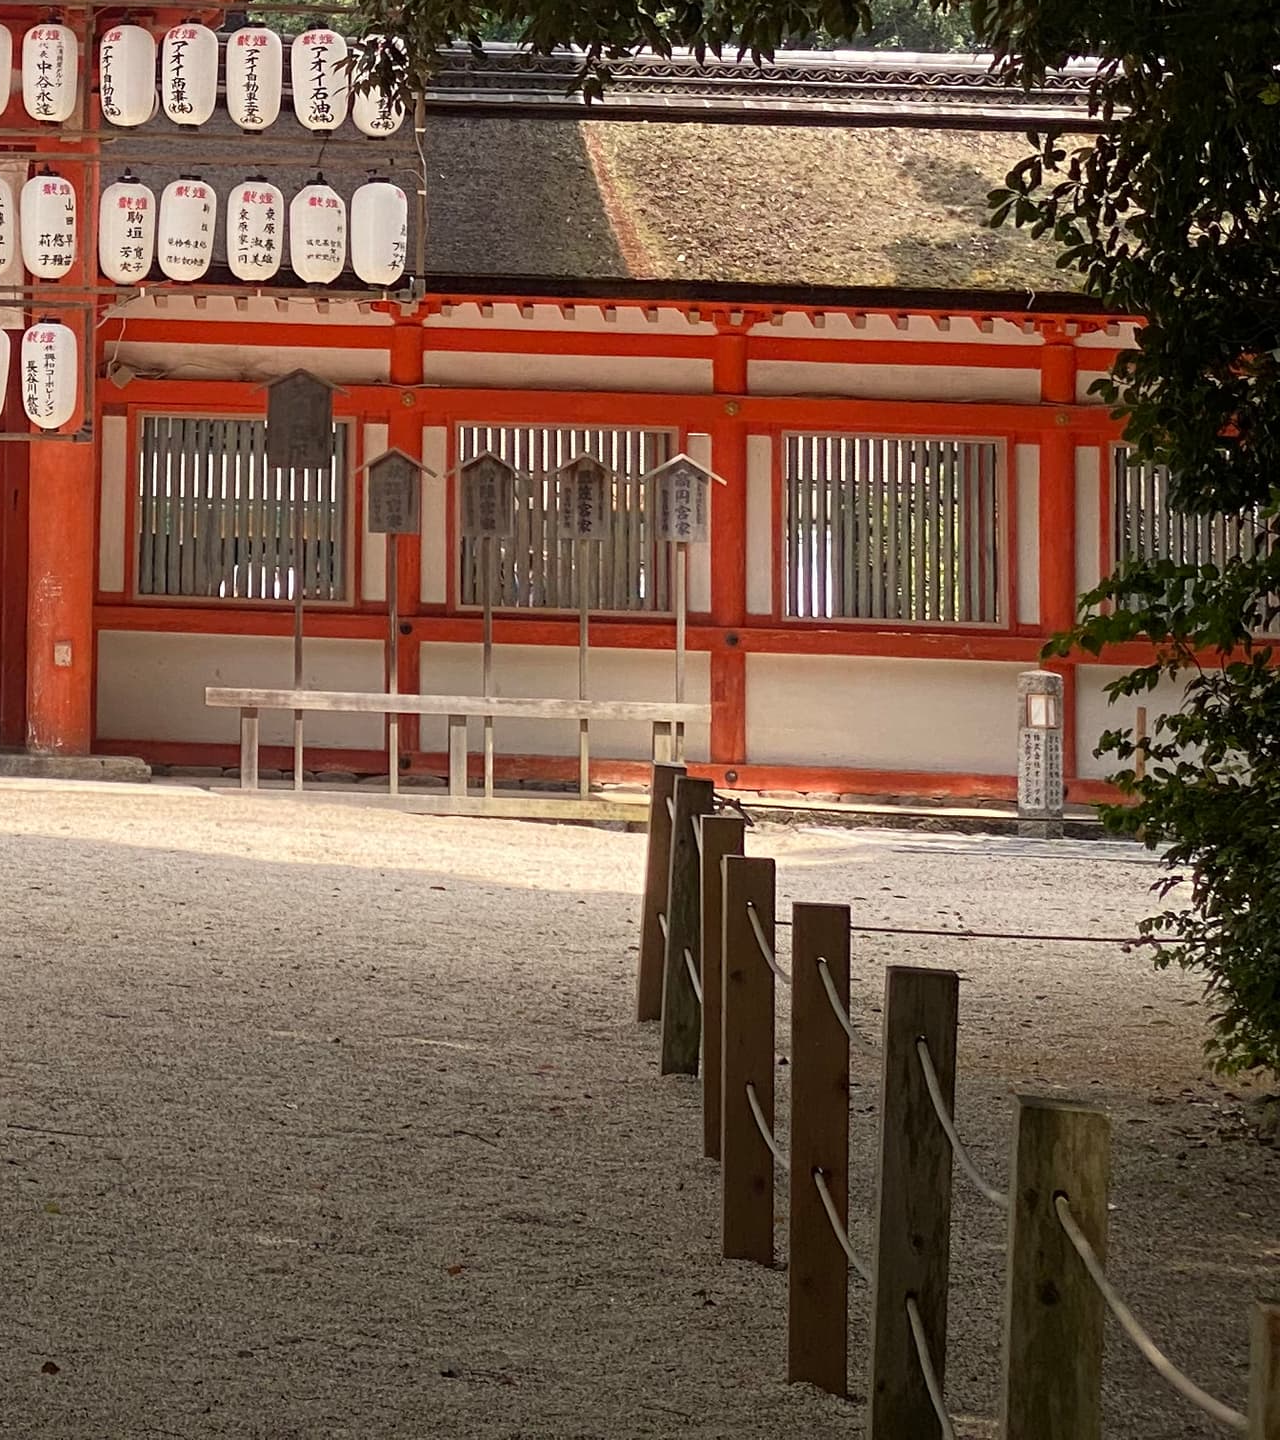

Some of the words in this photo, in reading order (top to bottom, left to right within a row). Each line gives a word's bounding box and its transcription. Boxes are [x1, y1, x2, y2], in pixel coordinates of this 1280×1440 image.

[168, 40, 193, 113] アオイ商事(株)
[240, 48, 262, 124] アオイ自動車工業(株)
[308, 47, 334, 123] アオイ石油(株)
